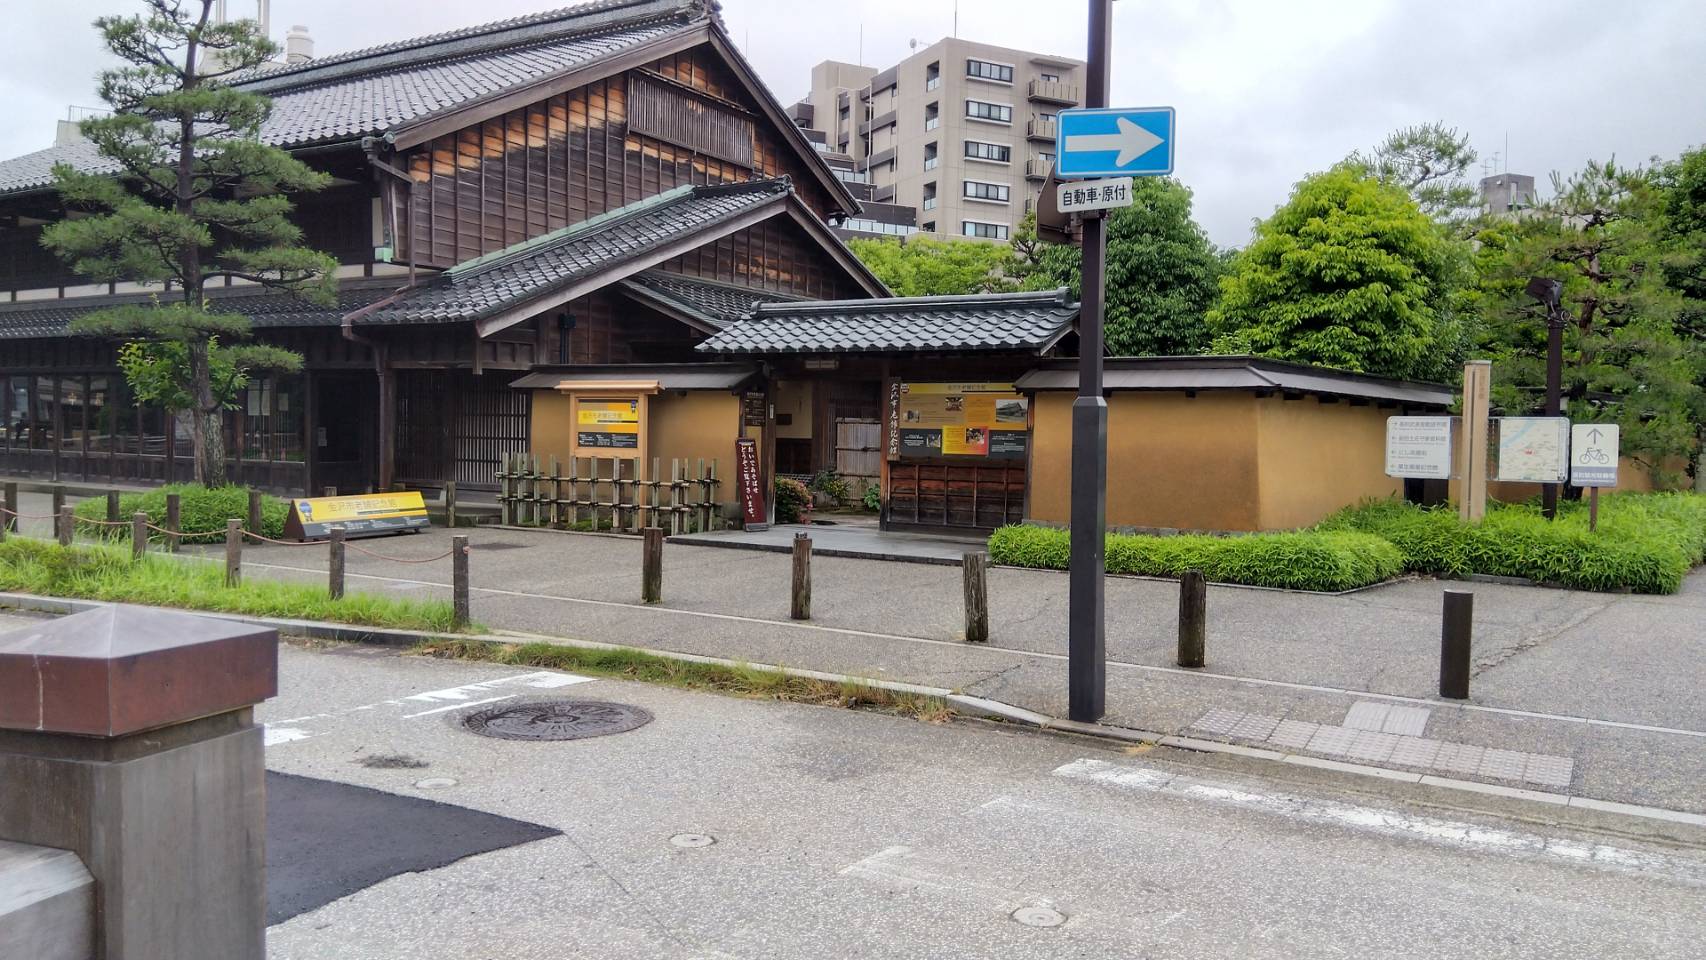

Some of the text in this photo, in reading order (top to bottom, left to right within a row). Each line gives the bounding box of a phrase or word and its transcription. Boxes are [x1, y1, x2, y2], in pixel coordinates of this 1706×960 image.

[748, 446, 759, 494] おいであそばせ
